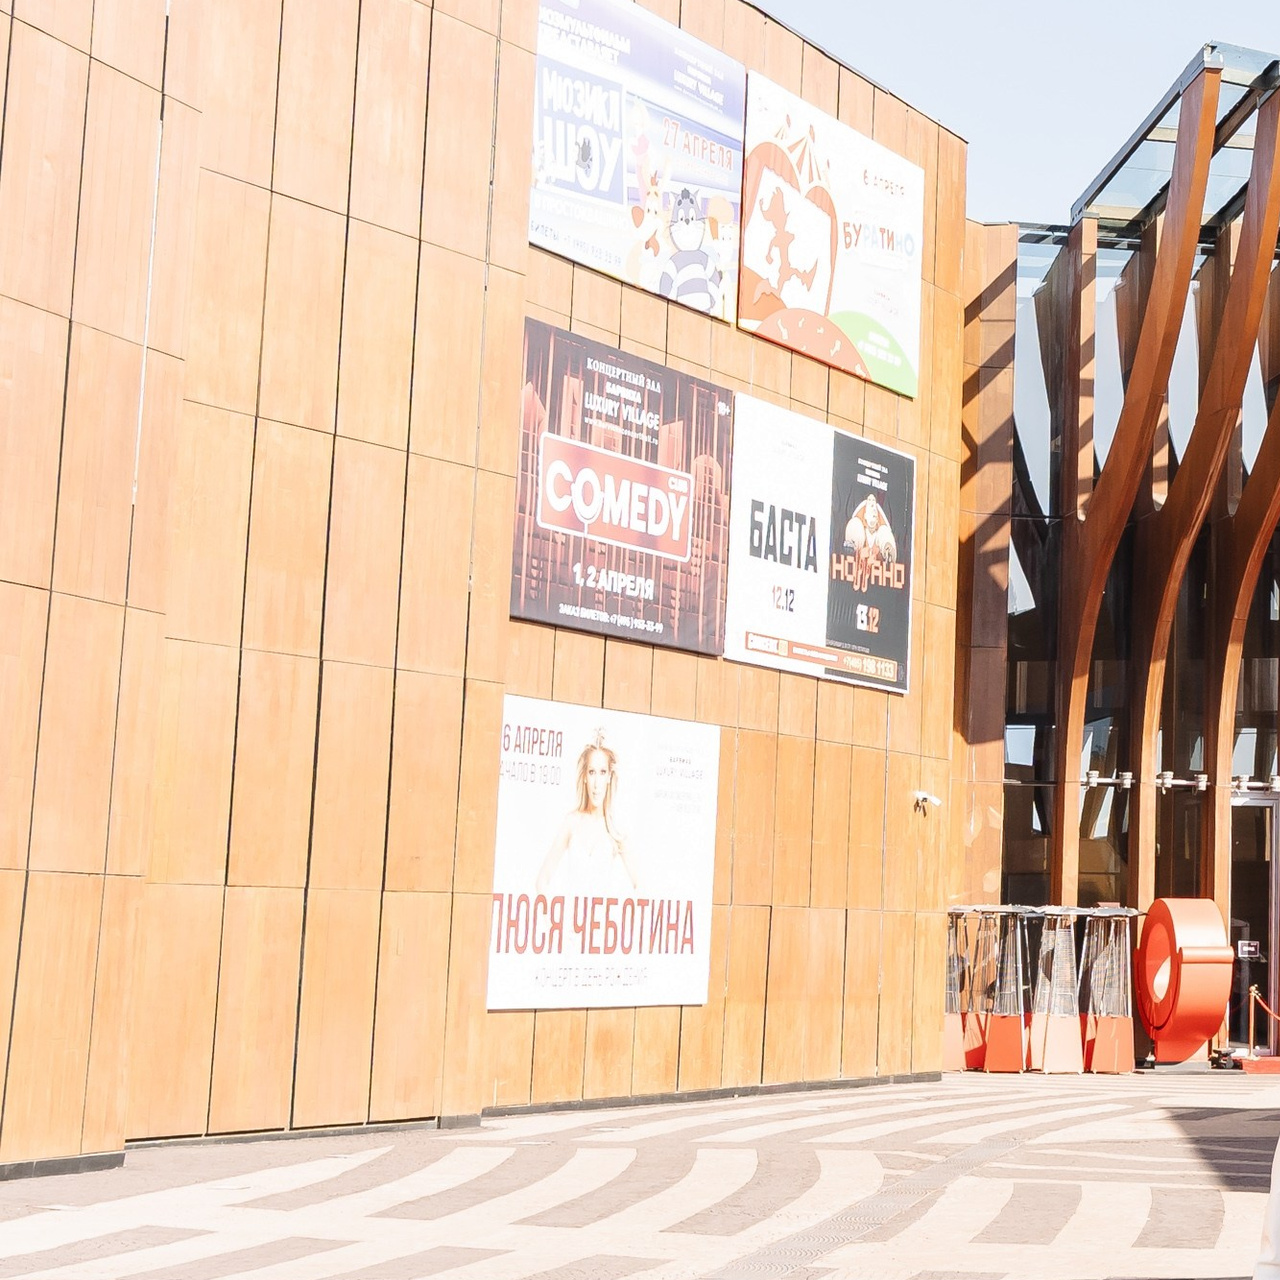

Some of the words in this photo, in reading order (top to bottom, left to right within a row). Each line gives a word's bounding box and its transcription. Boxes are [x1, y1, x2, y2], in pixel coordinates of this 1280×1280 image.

[542, 67, 621, 132] МЮЗИКЛ
[542, 111, 625, 193] ШОУ
[662, 117, 681, 149] 27
[682, 134, 735, 172] АПРЕЛЯ
[842, 221, 916, 257] БУРАТИНО
[586, 357, 646, 388] КОНЦЕРТНЫЙ
[584, 392, 620, 418] LUXURY
[621, 403, 660, 431] VILLAGE
[544, 459, 688, 541] COMEDY
[749, 499, 818, 574] БАСТА
[572, 562, 585, 587] 1,
[586, 565, 597, 588] 2
[597, 568, 655, 600] АПРЕЛЯ
[771, 584, 795, 613] 12.12
[503, 723, 512, 752] 6
[513, 725, 564, 758] АПРЕЛЯ
[573, 895, 694, 955] ЧЕБОТИНА
